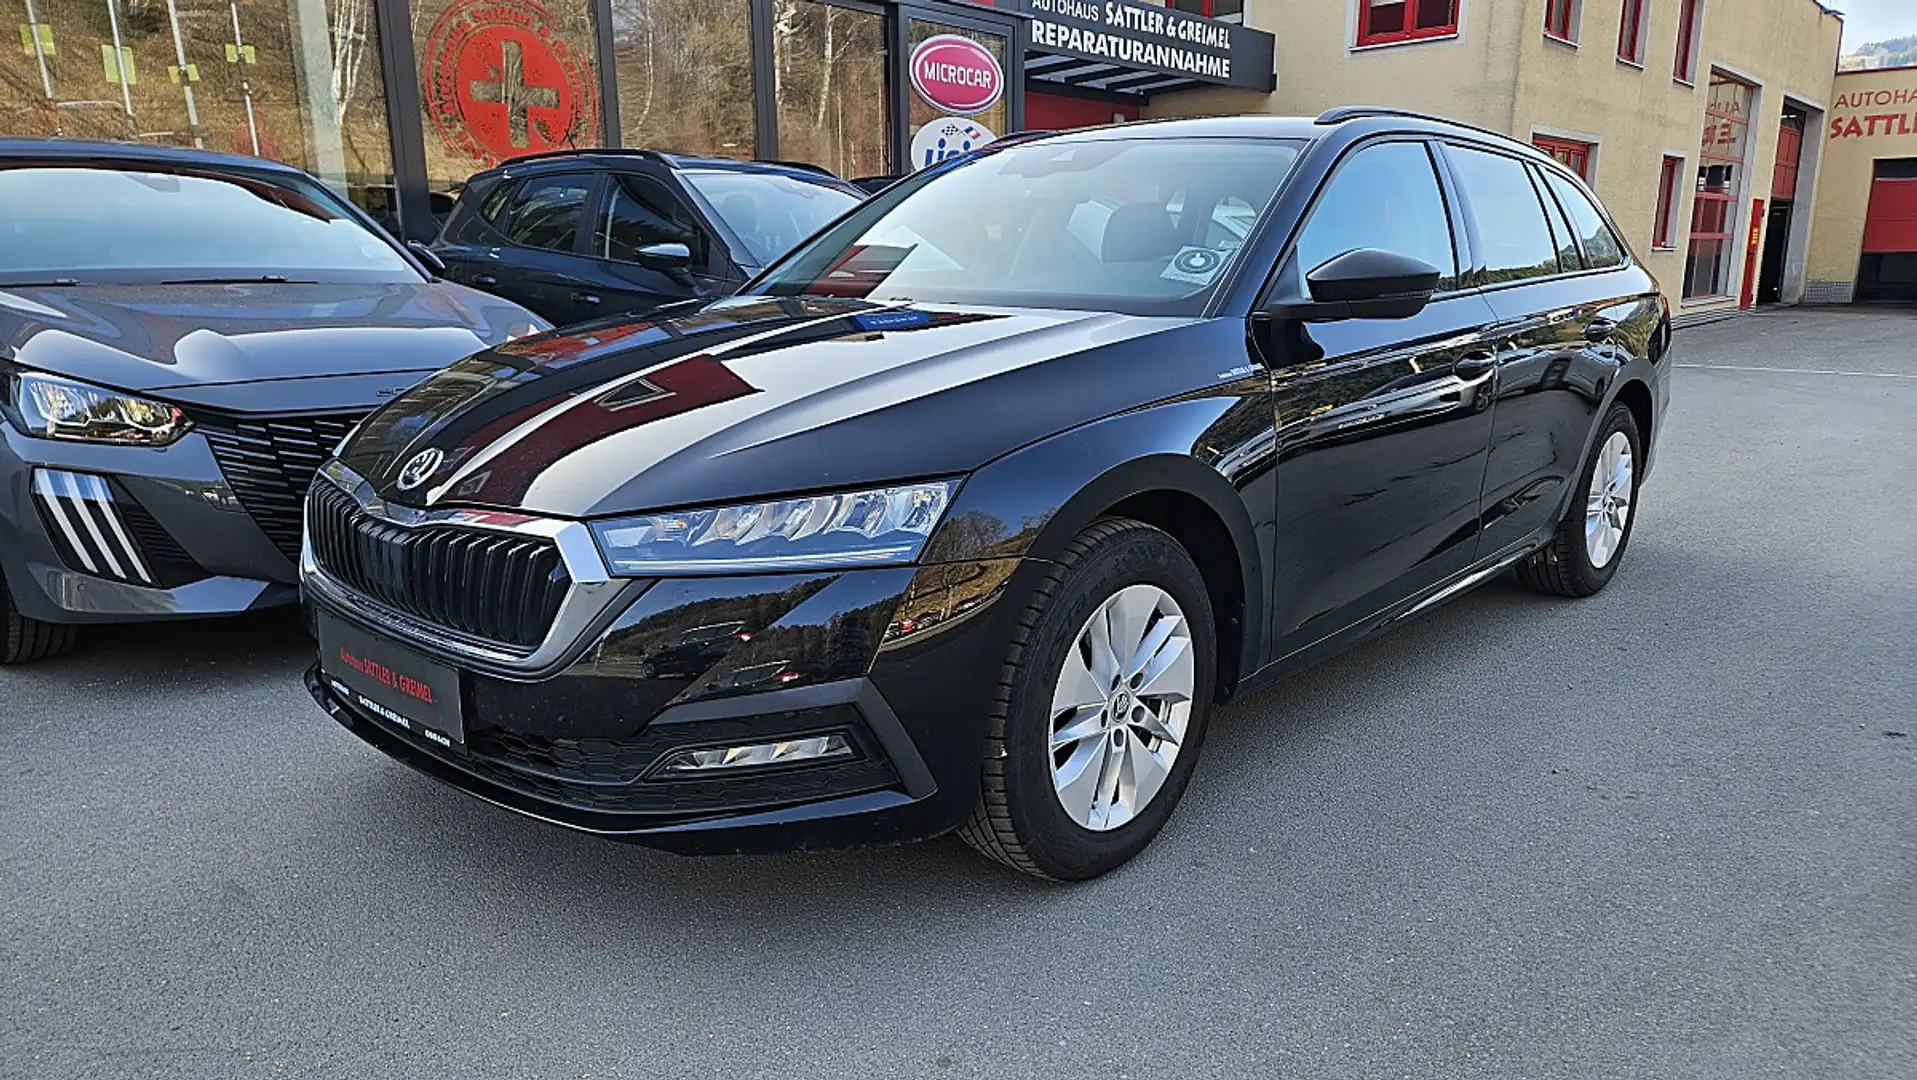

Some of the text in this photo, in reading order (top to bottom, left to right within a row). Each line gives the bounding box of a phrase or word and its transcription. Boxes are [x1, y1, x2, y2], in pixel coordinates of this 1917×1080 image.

[1105, 1, 1164, 35] SATTLER
[1166, 16, 1176, 38] &
[1178, 20, 1230, 49] GREIMEL
[1032, 19, 1230, 78] REPARATURANNAHME
[924, 61, 992, 89] MICROCAR
[364, 658, 391, 685] SATTLER
